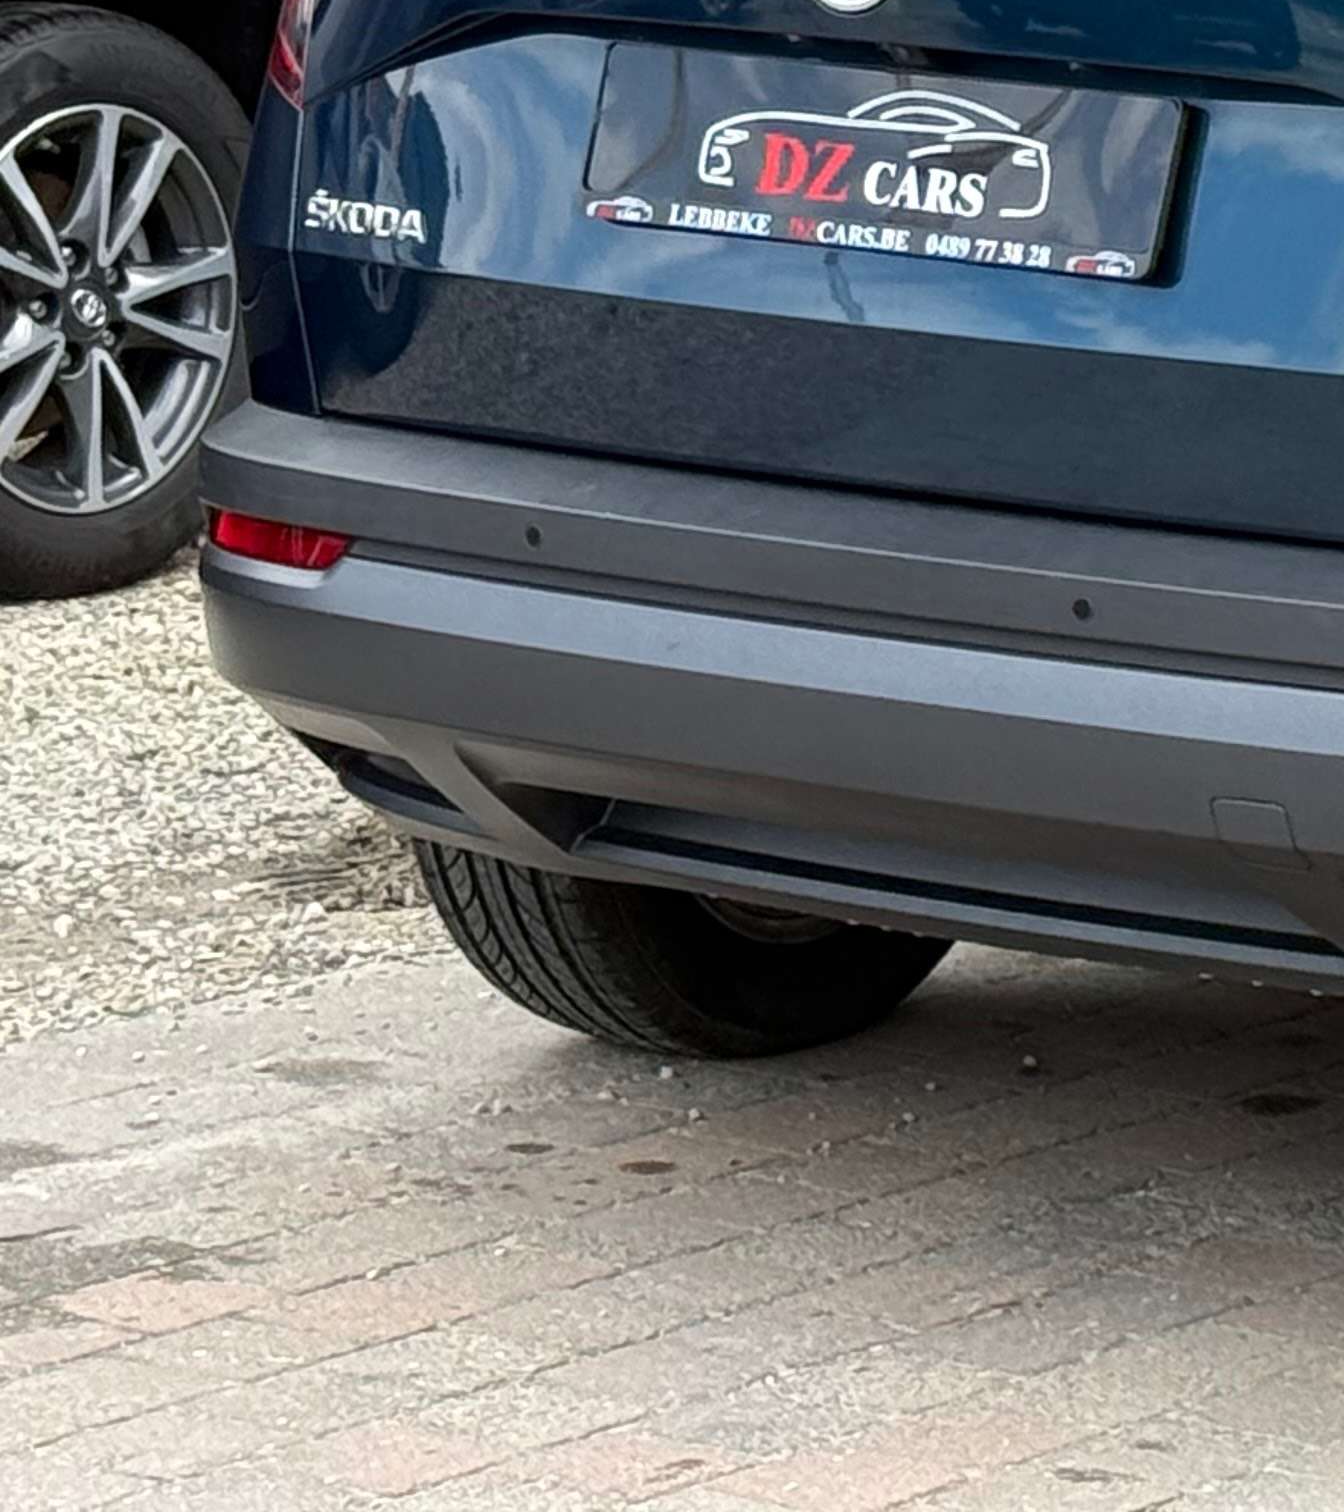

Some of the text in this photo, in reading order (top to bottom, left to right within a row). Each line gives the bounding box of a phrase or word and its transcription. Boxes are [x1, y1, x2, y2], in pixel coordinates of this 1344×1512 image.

[755, 131, 988, 218] DZ CARS
[304, 189, 427, 244] ŠKODA
[668, 203, 772, 236] LEBBEKE
[974, 238, 998, 262] 77
